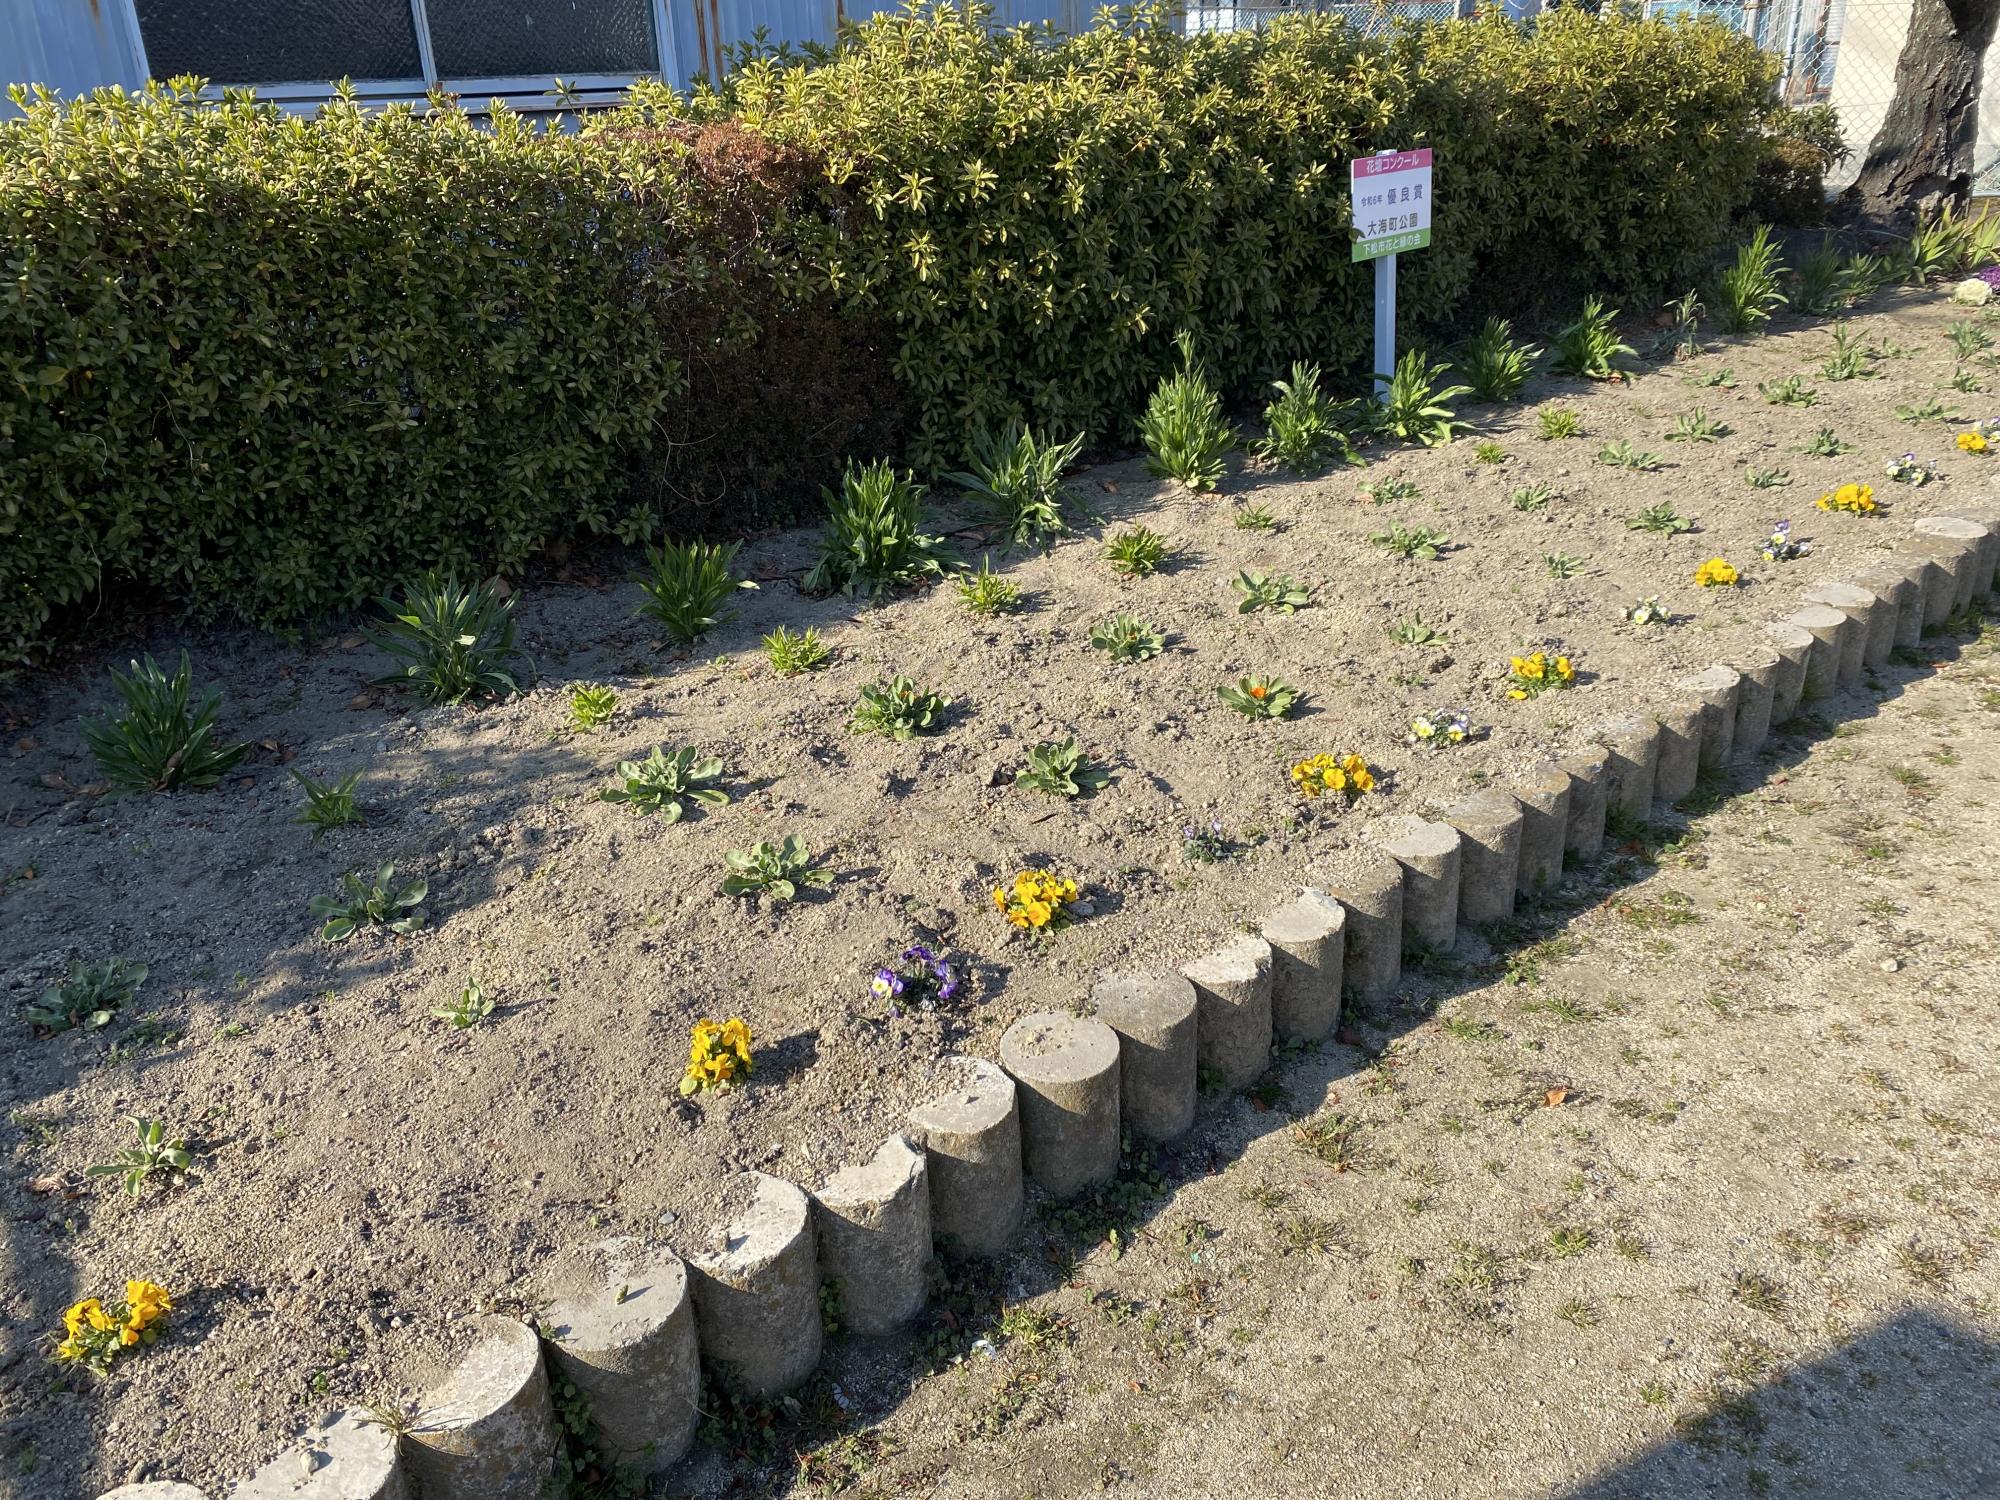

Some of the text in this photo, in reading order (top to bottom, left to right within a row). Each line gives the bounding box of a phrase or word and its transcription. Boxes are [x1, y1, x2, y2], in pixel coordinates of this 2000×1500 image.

[1366, 154, 1419, 174] 花壇コンクール
[1387, 184, 1423, 205] 優良賞
[1367, 212, 1418, 236] 大海町公園
